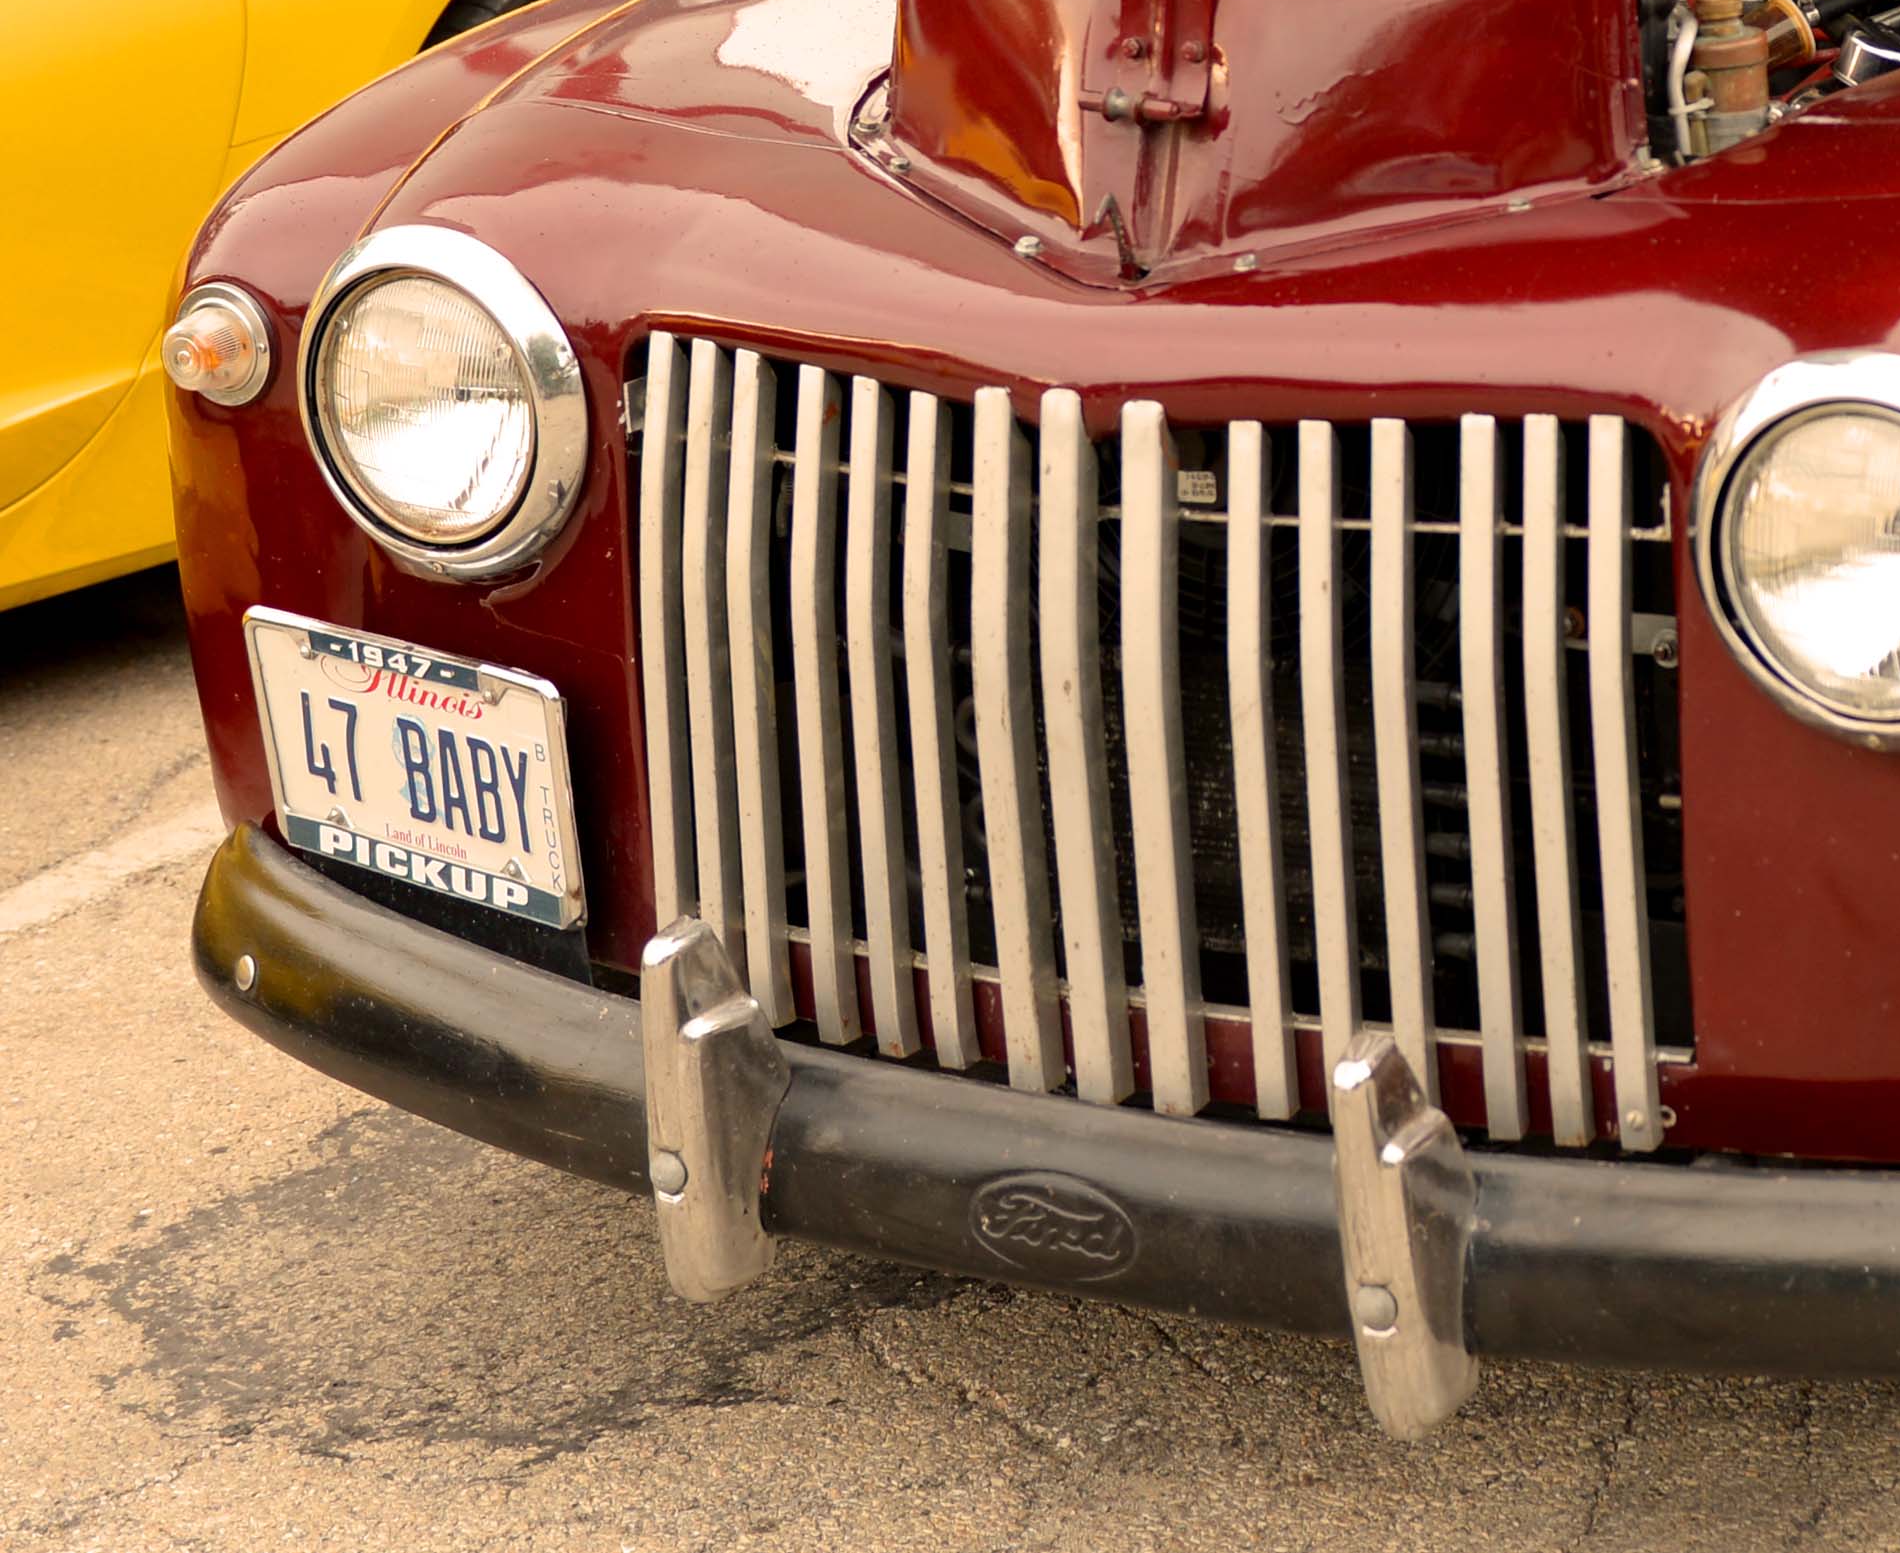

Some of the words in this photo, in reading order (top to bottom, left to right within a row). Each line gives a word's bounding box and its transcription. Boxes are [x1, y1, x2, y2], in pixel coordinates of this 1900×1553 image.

[320, 654, 487, 720] Illinois
[300, 690, 362, 802] 47
[396, 715, 532, 854] BABY
[385, 823, 413, 844] Land
[415, 833, 425, 847] of
[428, 835, 467, 860] Lincoln
[534, 743, 546, 762] B
[540, 785, 563, 892] TRUCK
[319, 824, 529, 908] PICKUP
